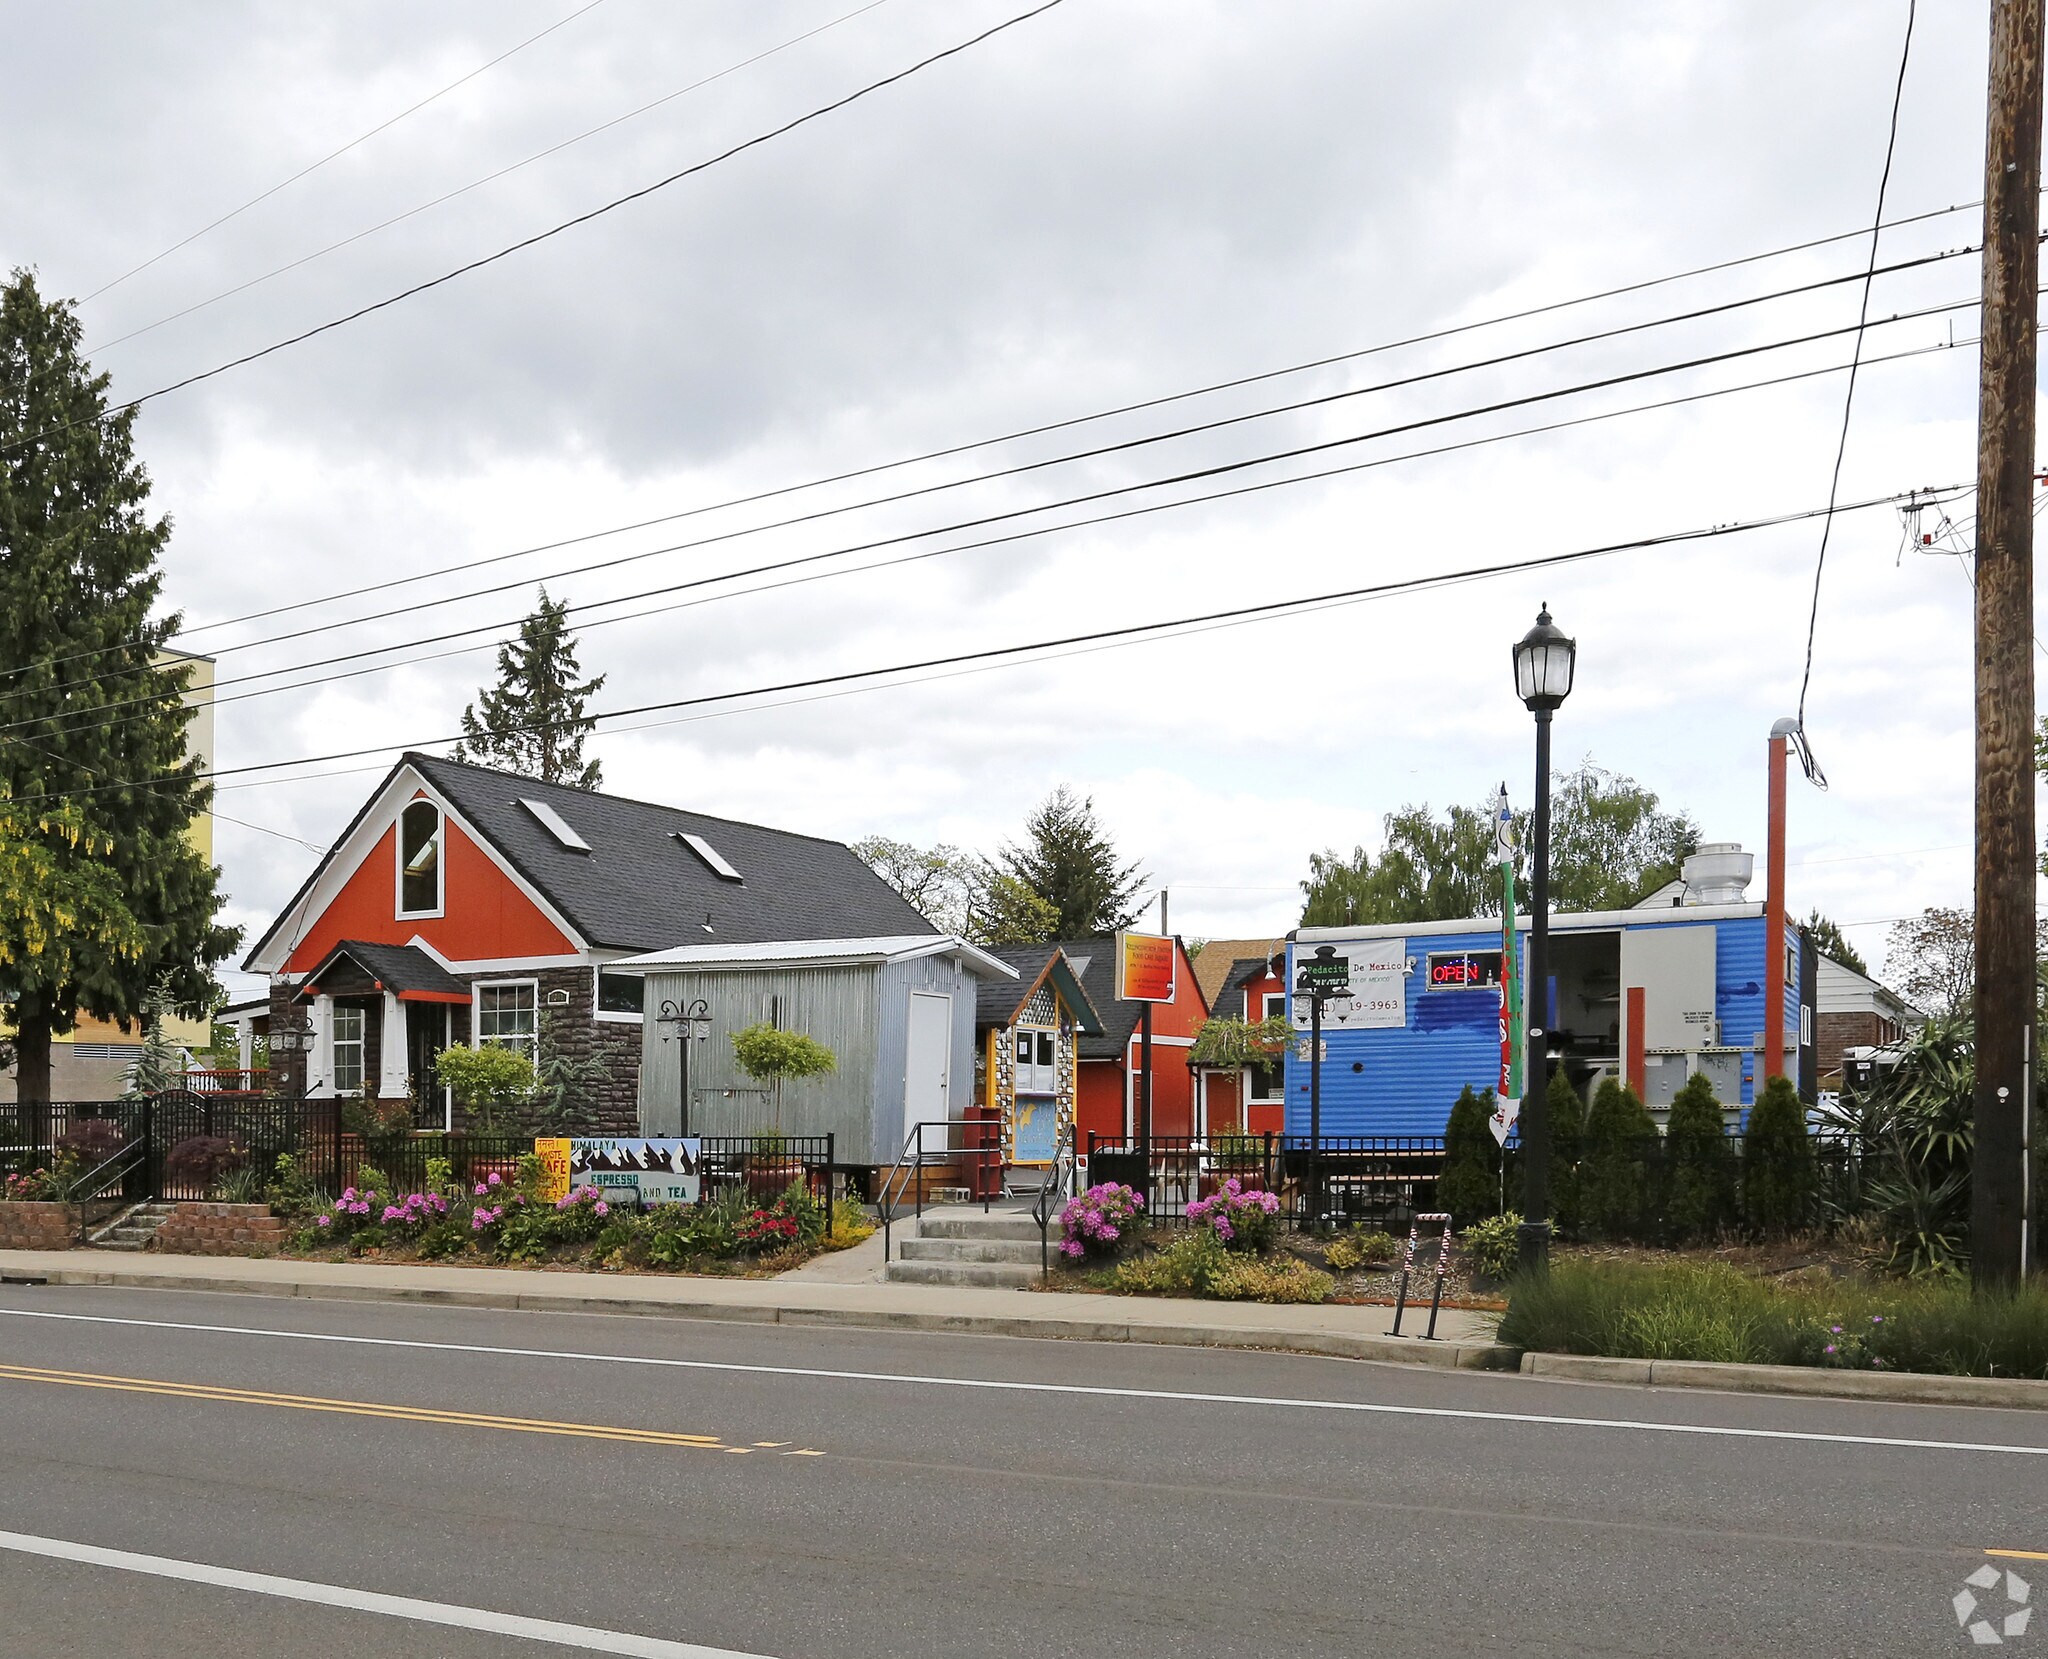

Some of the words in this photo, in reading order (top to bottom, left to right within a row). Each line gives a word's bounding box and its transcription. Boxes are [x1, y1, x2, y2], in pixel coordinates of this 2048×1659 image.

[1354, 963, 1364, 972] De
[1369, 962, 1402, 971] Mexico
[1433, 965, 1478, 981] OPEN
[1348, 999, 1399, 1011] 19-3963
[571, 1140, 617, 1150] HIMALAYA
[540, 1160, 567, 1174] AFE
[591, 1174, 639, 1185] ESPRESSO
[643, 1187, 661, 1198] AND
[668, 1187, 687, 1198] TEA
